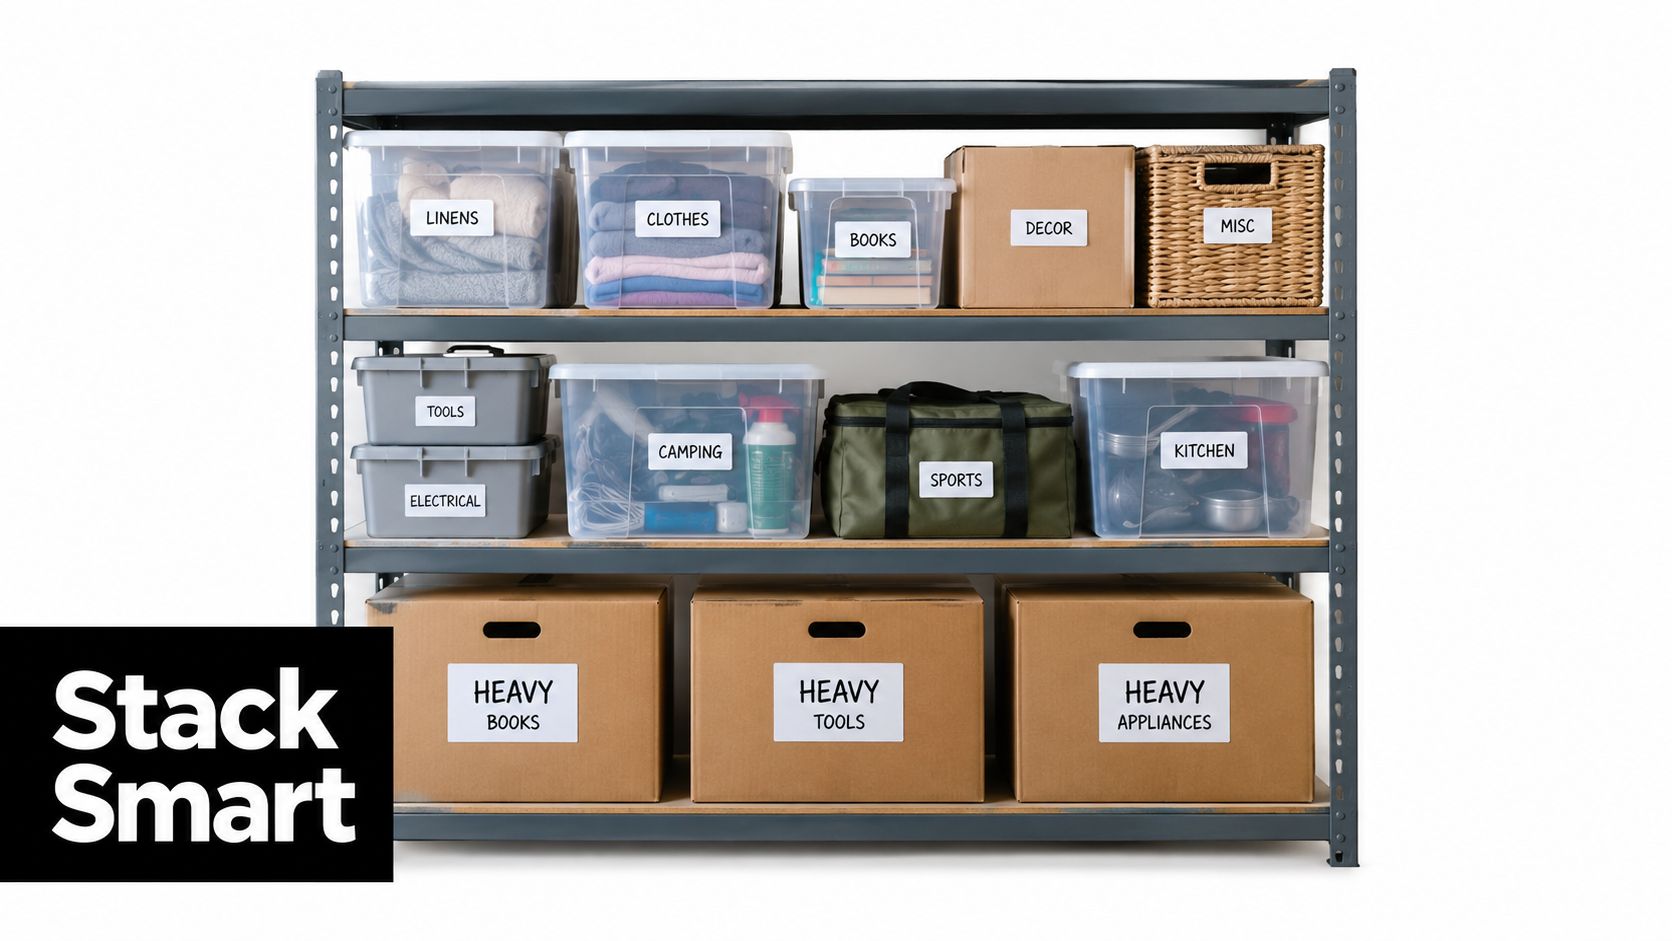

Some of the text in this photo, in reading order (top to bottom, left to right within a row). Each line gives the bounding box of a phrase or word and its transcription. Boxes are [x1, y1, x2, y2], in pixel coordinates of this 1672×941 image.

[426, 210, 479, 225] LINENS
[646, 211, 709, 227] CLOTHES
[1221, 218, 1255, 233] MISC
[1025, 221, 1073, 236] DECOR
[850, 232, 897, 248] BOOKS
[426, 405, 465, 418] TOOLS
[658, 444, 723, 459] CAMPING
[1174, 443, 1235, 458] KITCHEN
[930, 472, 983, 488] SPORTS
[410, 494, 481, 508] ELECTRICAL
[474, 679, 554, 705] HEAVY
[799, 678, 880, 704] HEAVY
[1125, 679, 1206, 705] HEAVY
[486, 714, 540, 731] BOOKS
[813, 713, 866, 730] TOOLS
[1117, 714, 1212, 731] APPLIANCES
